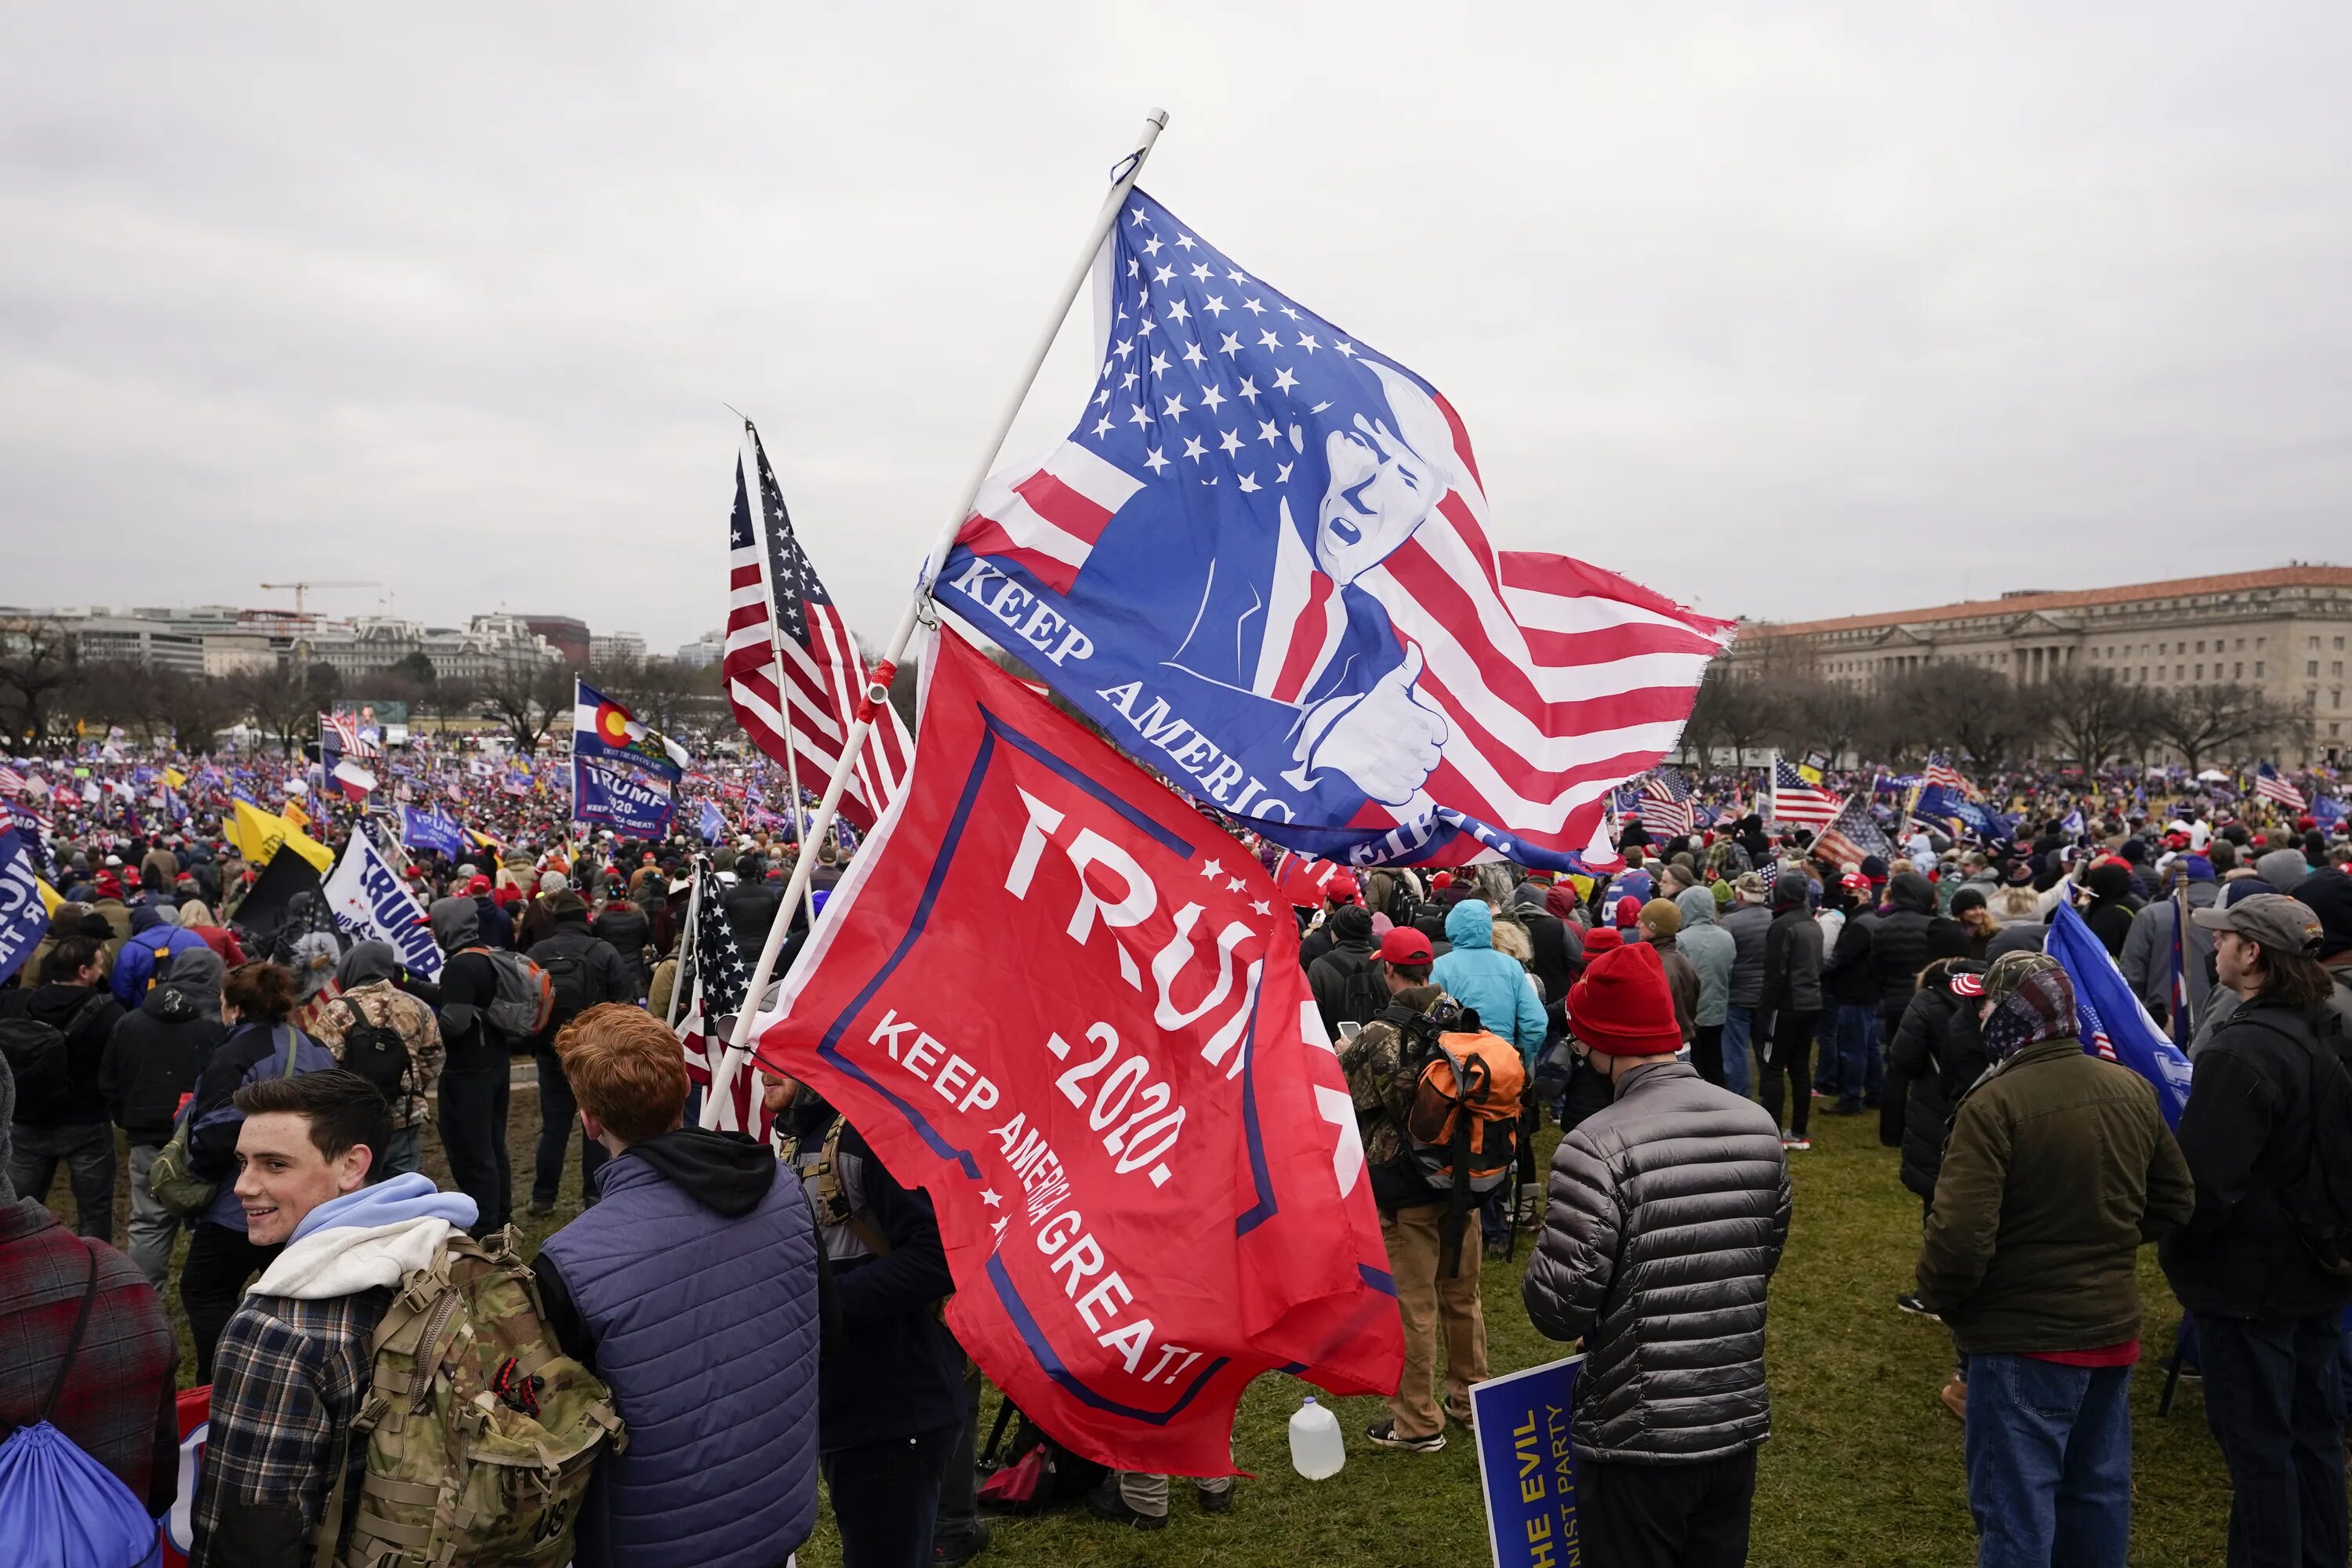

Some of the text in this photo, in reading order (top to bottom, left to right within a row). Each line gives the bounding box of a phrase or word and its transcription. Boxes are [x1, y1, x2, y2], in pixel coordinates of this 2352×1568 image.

[949, 557, 1296, 824] KEEP AMERIC
[586, 765, 666, 808] TRUMP
[586, 804, 608, 813] KEEP
[626, 818, 655, 829] GREAT!
[360, 848, 442, 974] TRUMP
[1004, 784, 1265, 1081] TRU
[868, 1008, 1204, 1385] KEEP AMERICA GREAT!
[1513, 1410, 1546, 1504] EVIL
[1545, 1404, 1575, 1494] PARTY
[533, 1498, 568, 1544] US
